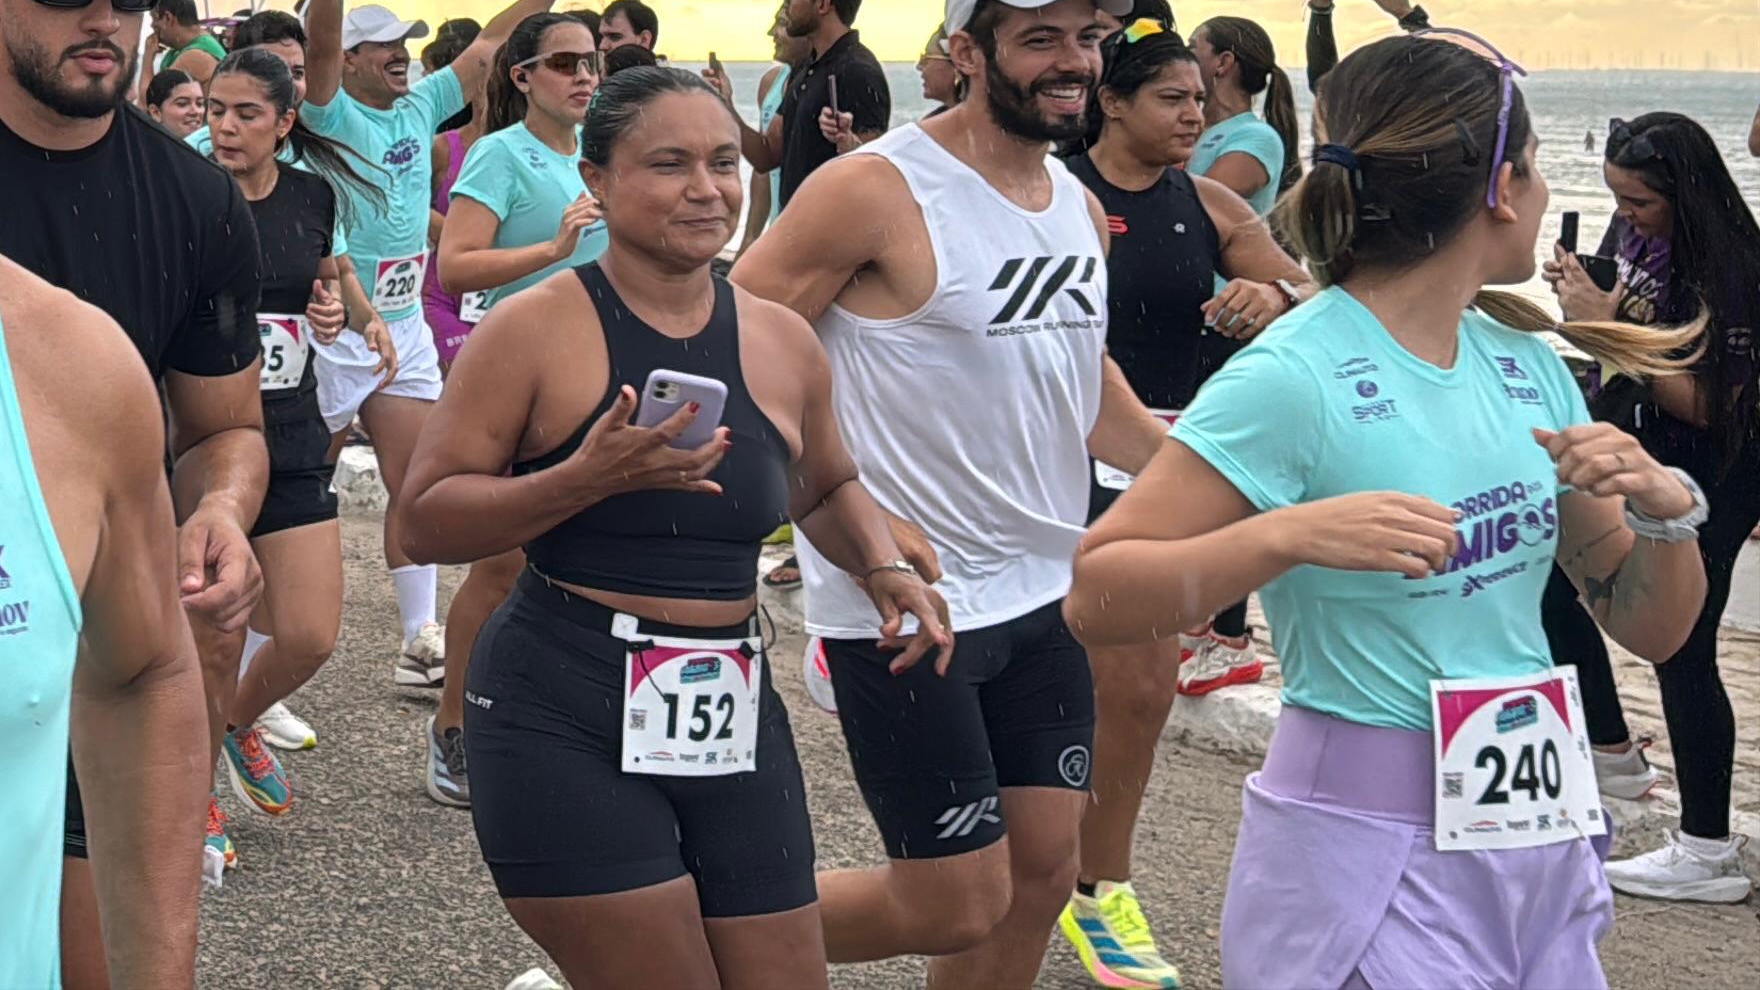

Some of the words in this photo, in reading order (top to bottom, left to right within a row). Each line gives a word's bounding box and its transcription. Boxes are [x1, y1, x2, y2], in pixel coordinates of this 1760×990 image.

[384, 273, 416, 298] 220
[475, 292, 488, 310] 2
[986, 324, 1041, 338] MOSCOW
[260, 344, 284, 372] 5
[1450, 480, 1528, 524] ORRIDA
[1405, 497, 1555, 578] MIGOS
[663, 691, 735, 742] 152
[1474, 737, 1562, 805] 240
